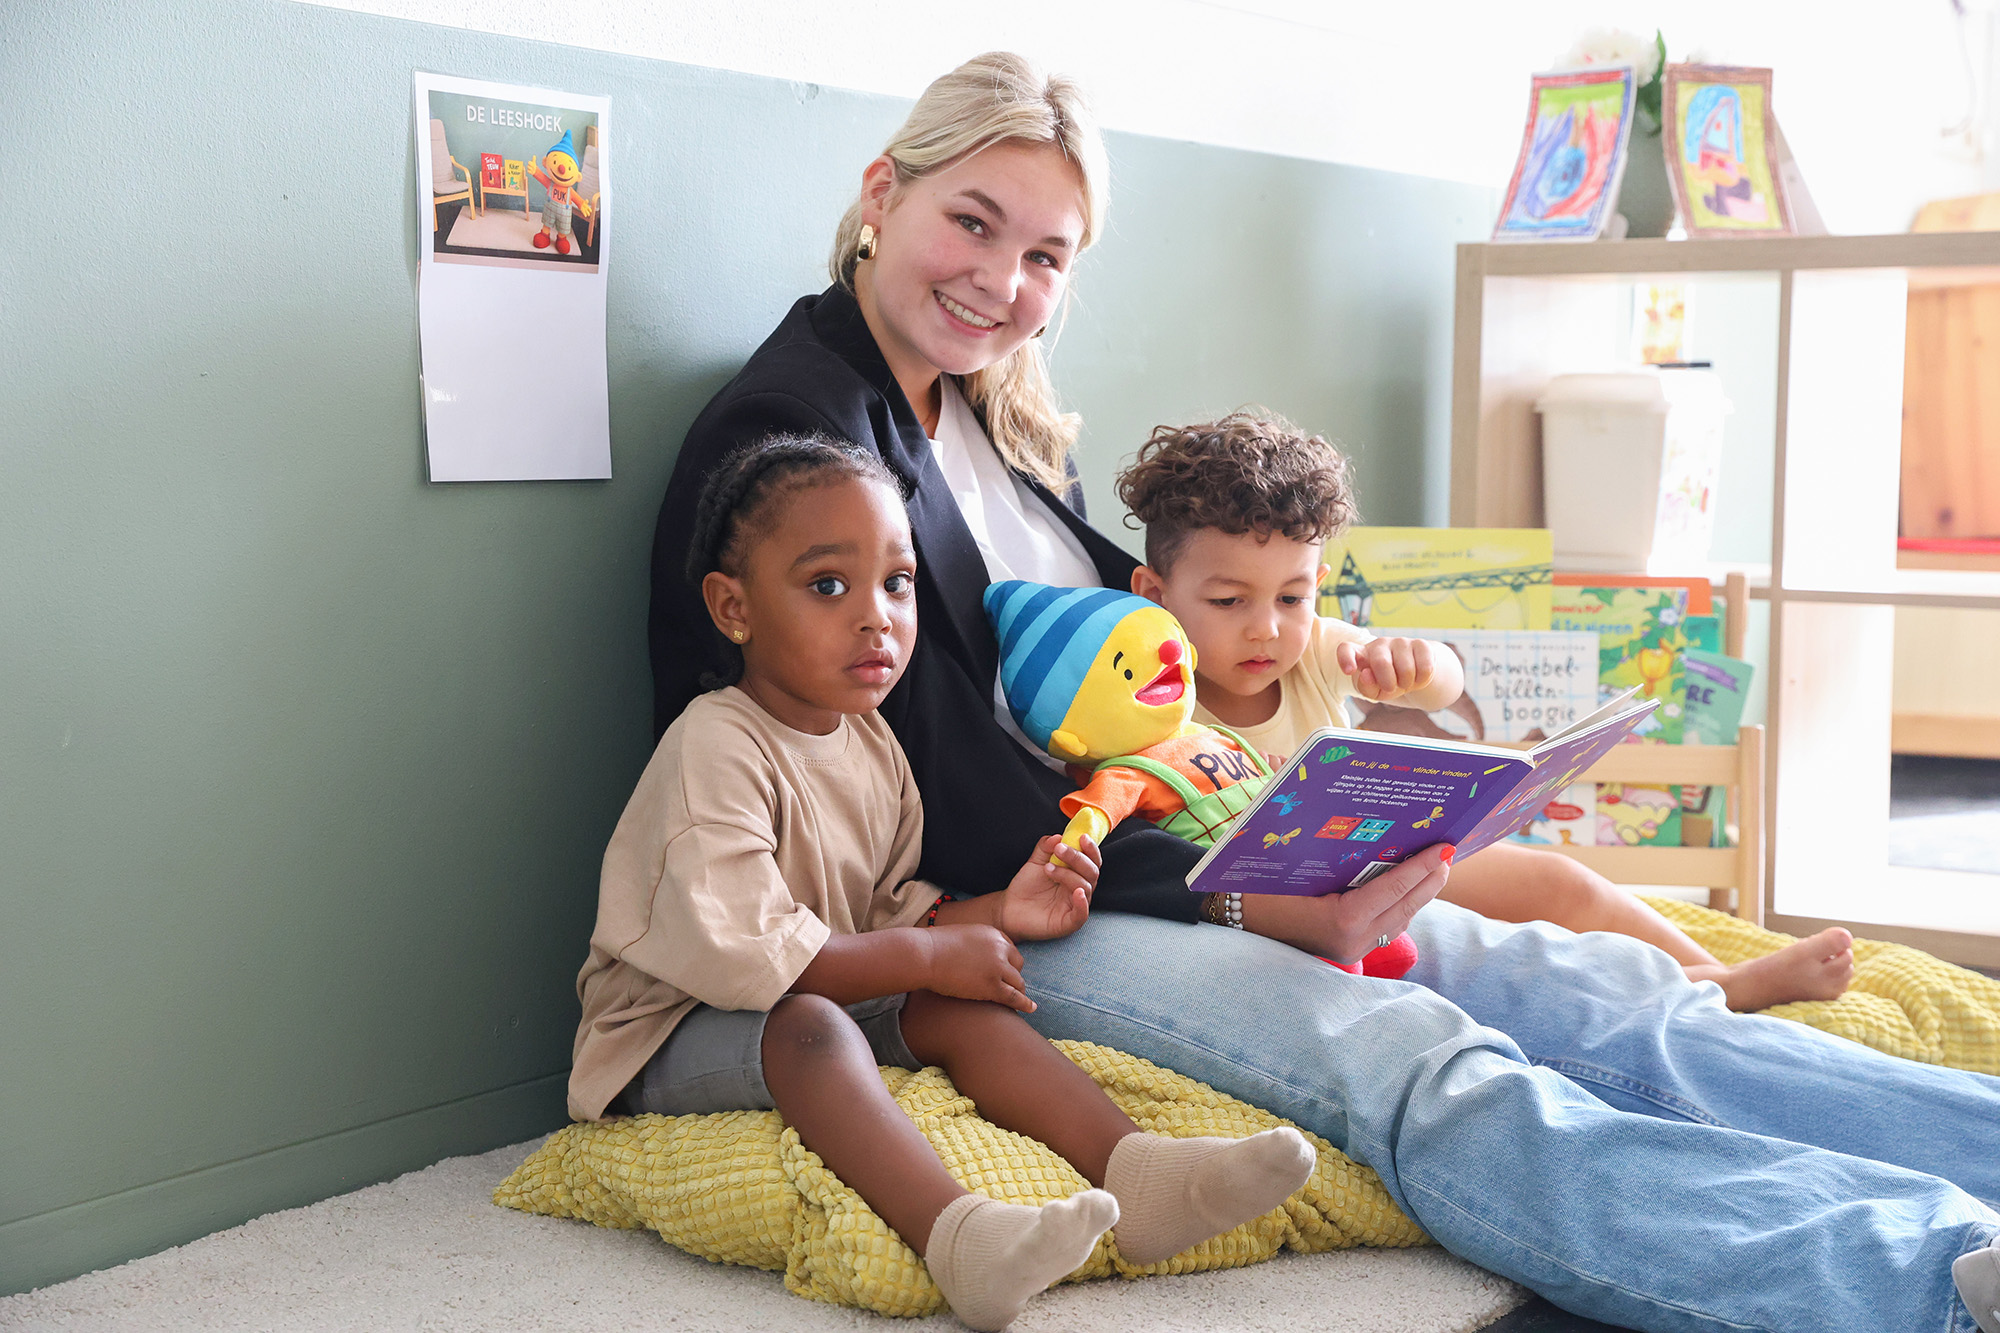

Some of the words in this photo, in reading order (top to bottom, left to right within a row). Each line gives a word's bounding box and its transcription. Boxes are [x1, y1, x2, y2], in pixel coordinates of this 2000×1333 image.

[466, 105, 486, 123] DE
[490, 108, 562, 133] LEESHOEK
[552, 188, 566, 201] PUK
[1480, 657, 1502, 676] De
[1505, 656, 1579, 677] wiebel-
[1492, 679, 1564, 699] billen-
[1502, 701, 1576, 728] boogie
[1189, 748, 1260, 790] PUK
[1350, 759, 1366, 768] Kun
[1366, 761, 1379, 770] jij
[1378, 762, 1390, 770] de
[1413, 766, 1441, 776] vlinder
[1340, 774, 1364, 782] Kleintjes
[1391, 780, 1418, 788] geweldig
